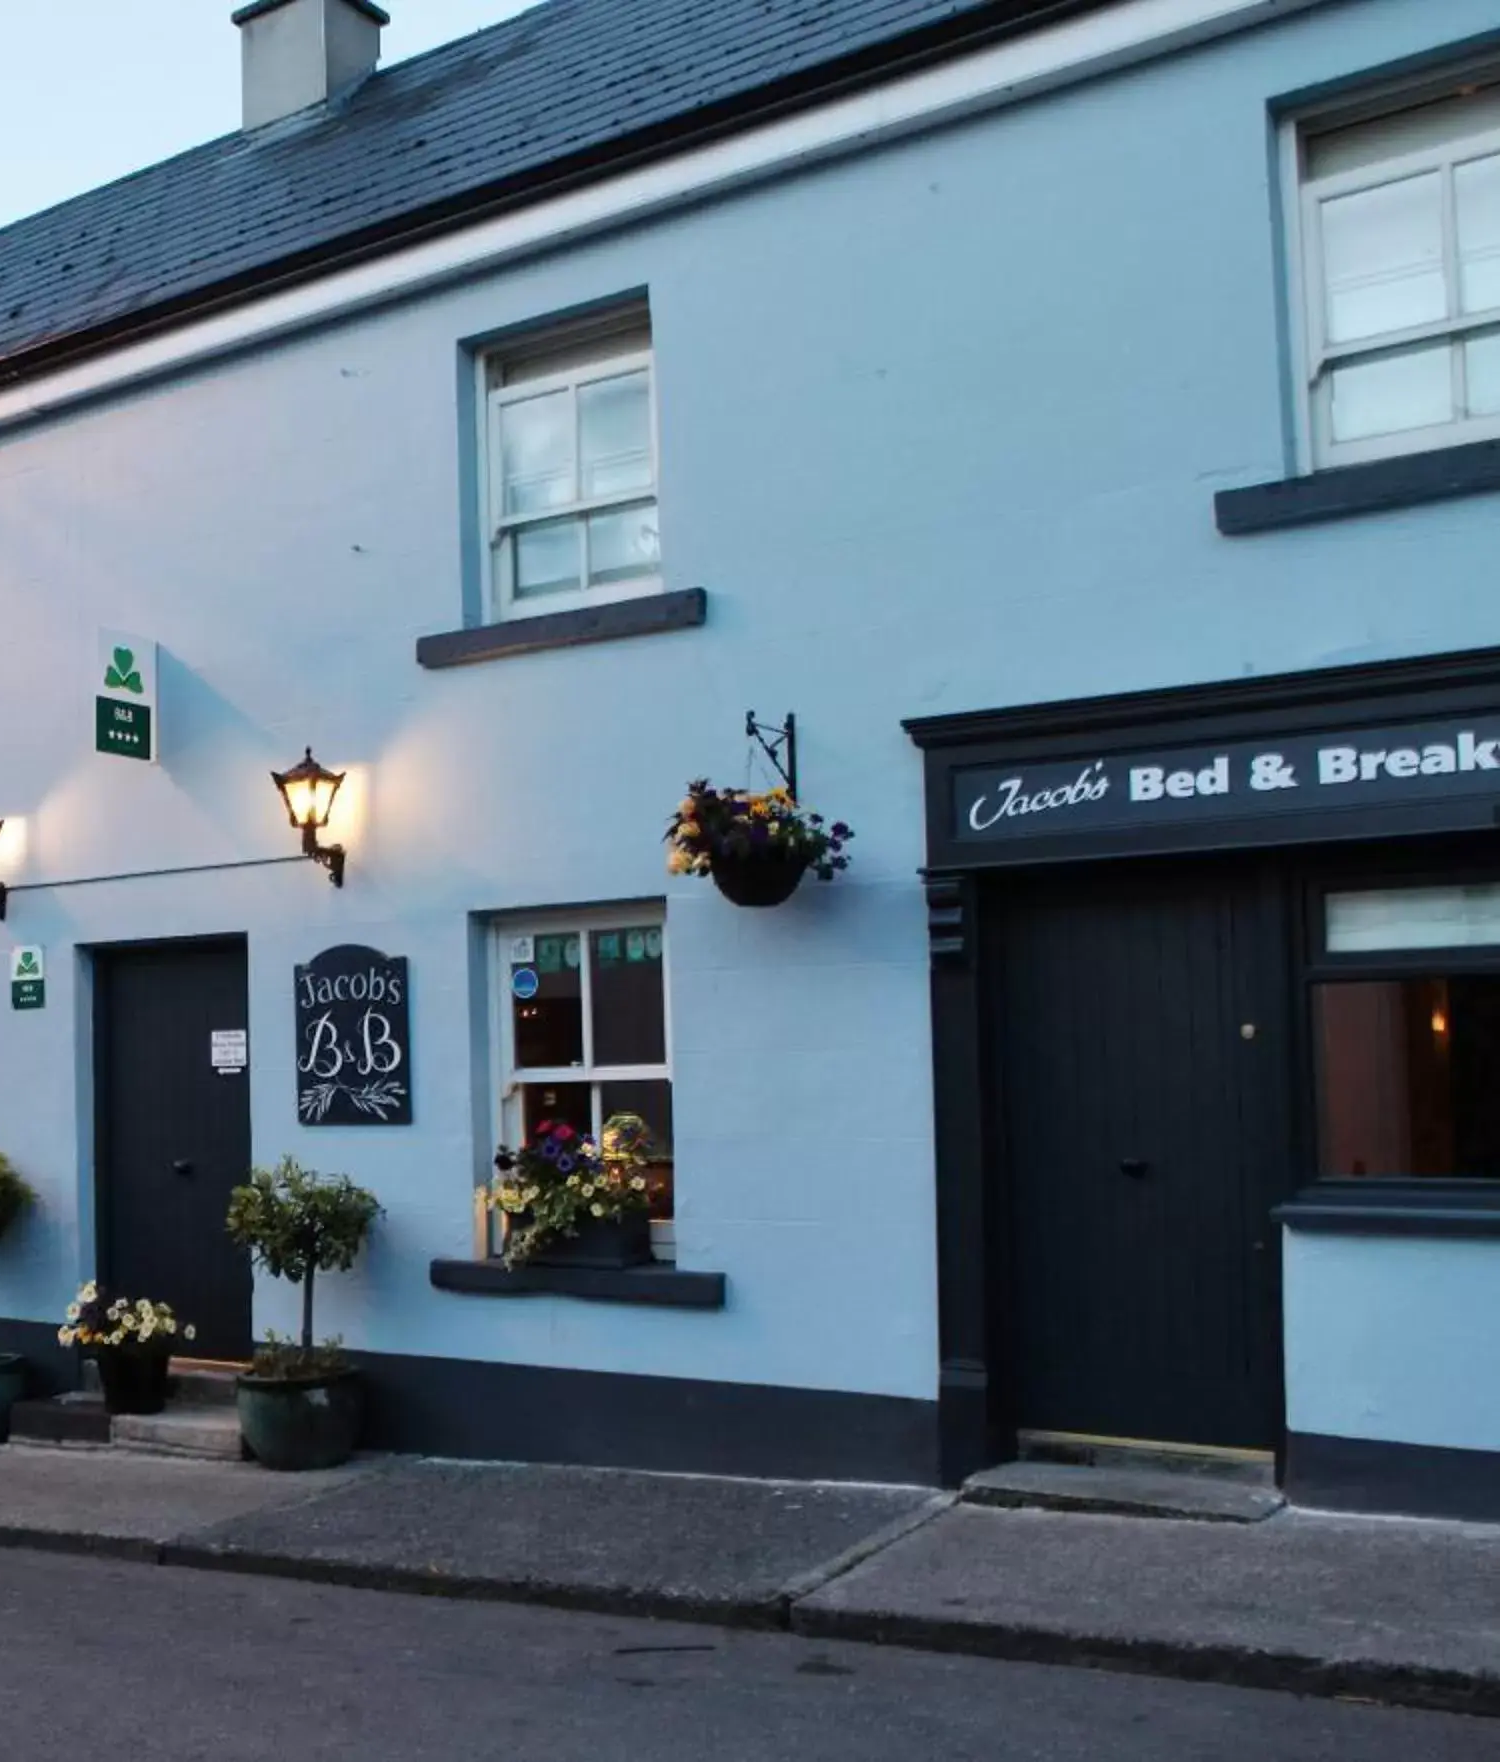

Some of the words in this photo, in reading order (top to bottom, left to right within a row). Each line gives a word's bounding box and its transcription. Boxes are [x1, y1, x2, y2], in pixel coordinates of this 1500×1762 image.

[968, 758, 1111, 832] Jacob's
[1129, 754, 1231, 802] Bed
[1250, 752, 1299, 791] &
[300, 967, 401, 1008] Jacob's
